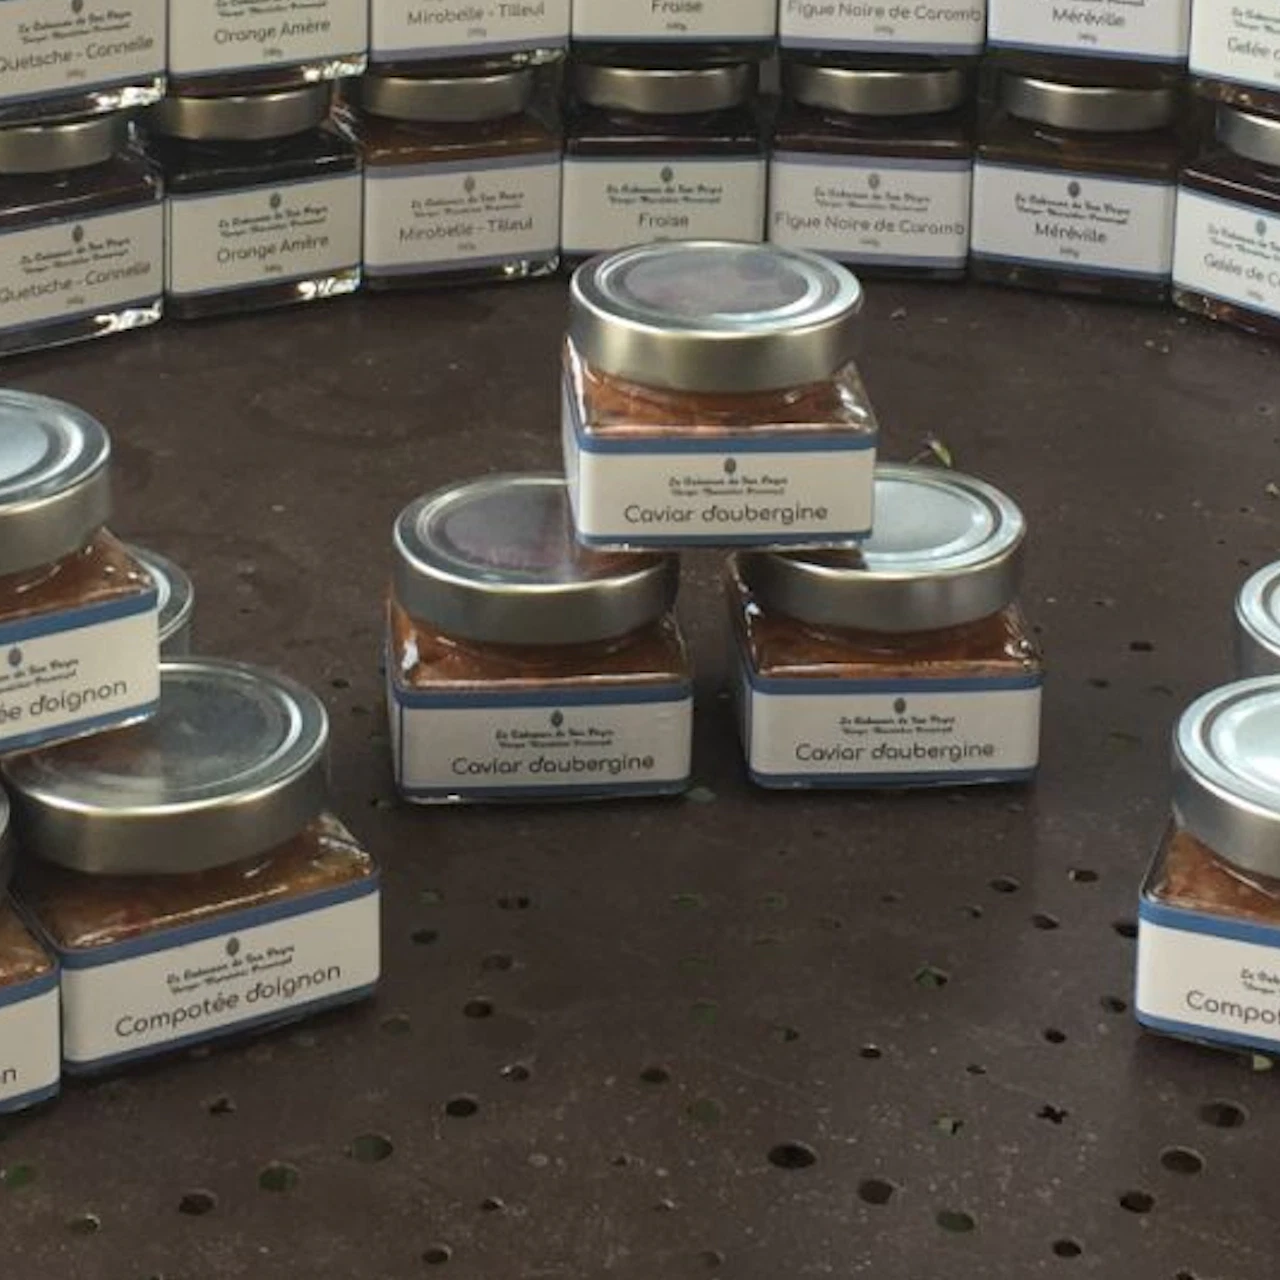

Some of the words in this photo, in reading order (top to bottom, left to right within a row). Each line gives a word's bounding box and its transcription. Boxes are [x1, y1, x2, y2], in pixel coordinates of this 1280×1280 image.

[407, 8, 484, 26] Mirabelle
[839, 3, 885, 18] Noire
[889, 4, 911, 19] de
[214, 27, 276, 45] Orange
[775, 211, 820, 230] Figue
[825, 215, 869, 231] Noire
[874, 218, 894, 232] de
[217, 245, 277, 263] Orange
[1246, 267, 1264, 281] de
[624, 504, 696, 524] Caviar
[795, 743, 867, 761] Caviar
[451, 756, 523, 775] Caviar
[115, 992, 240, 1037] Compotée
